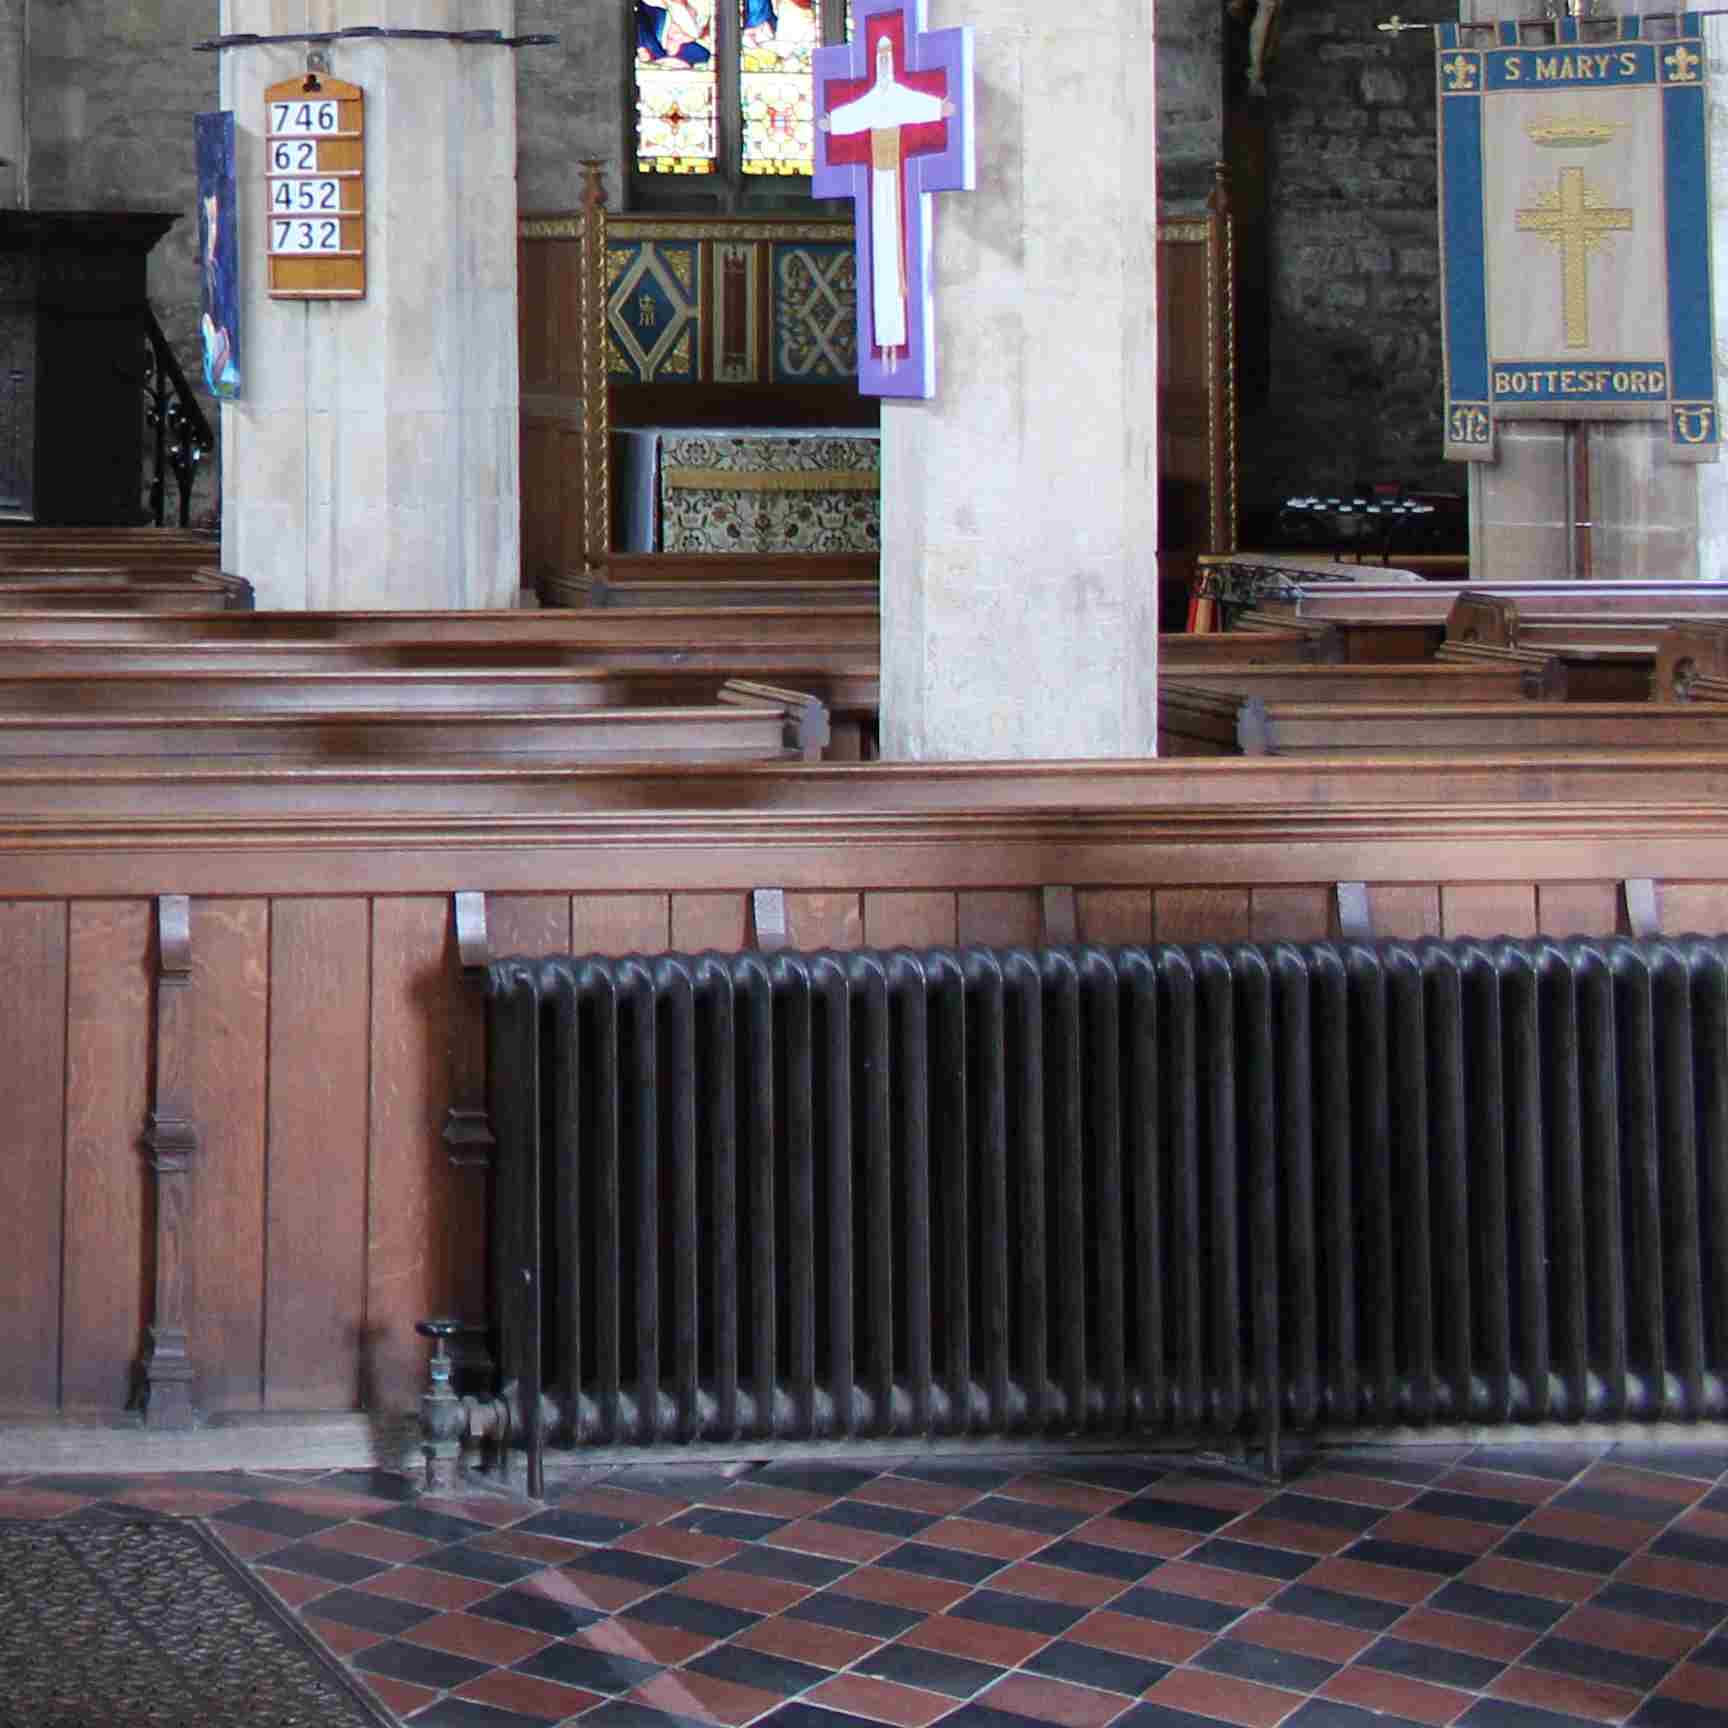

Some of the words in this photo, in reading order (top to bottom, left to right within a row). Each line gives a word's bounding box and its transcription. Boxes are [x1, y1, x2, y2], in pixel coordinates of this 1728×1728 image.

[274, 103, 334, 133] 746
[274, 143, 314, 170] 62
[274, 183, 338, 209] 452
[274, 222, 338, 250] 732
[1495, 370, 1665, 393] BOTTESFORD
